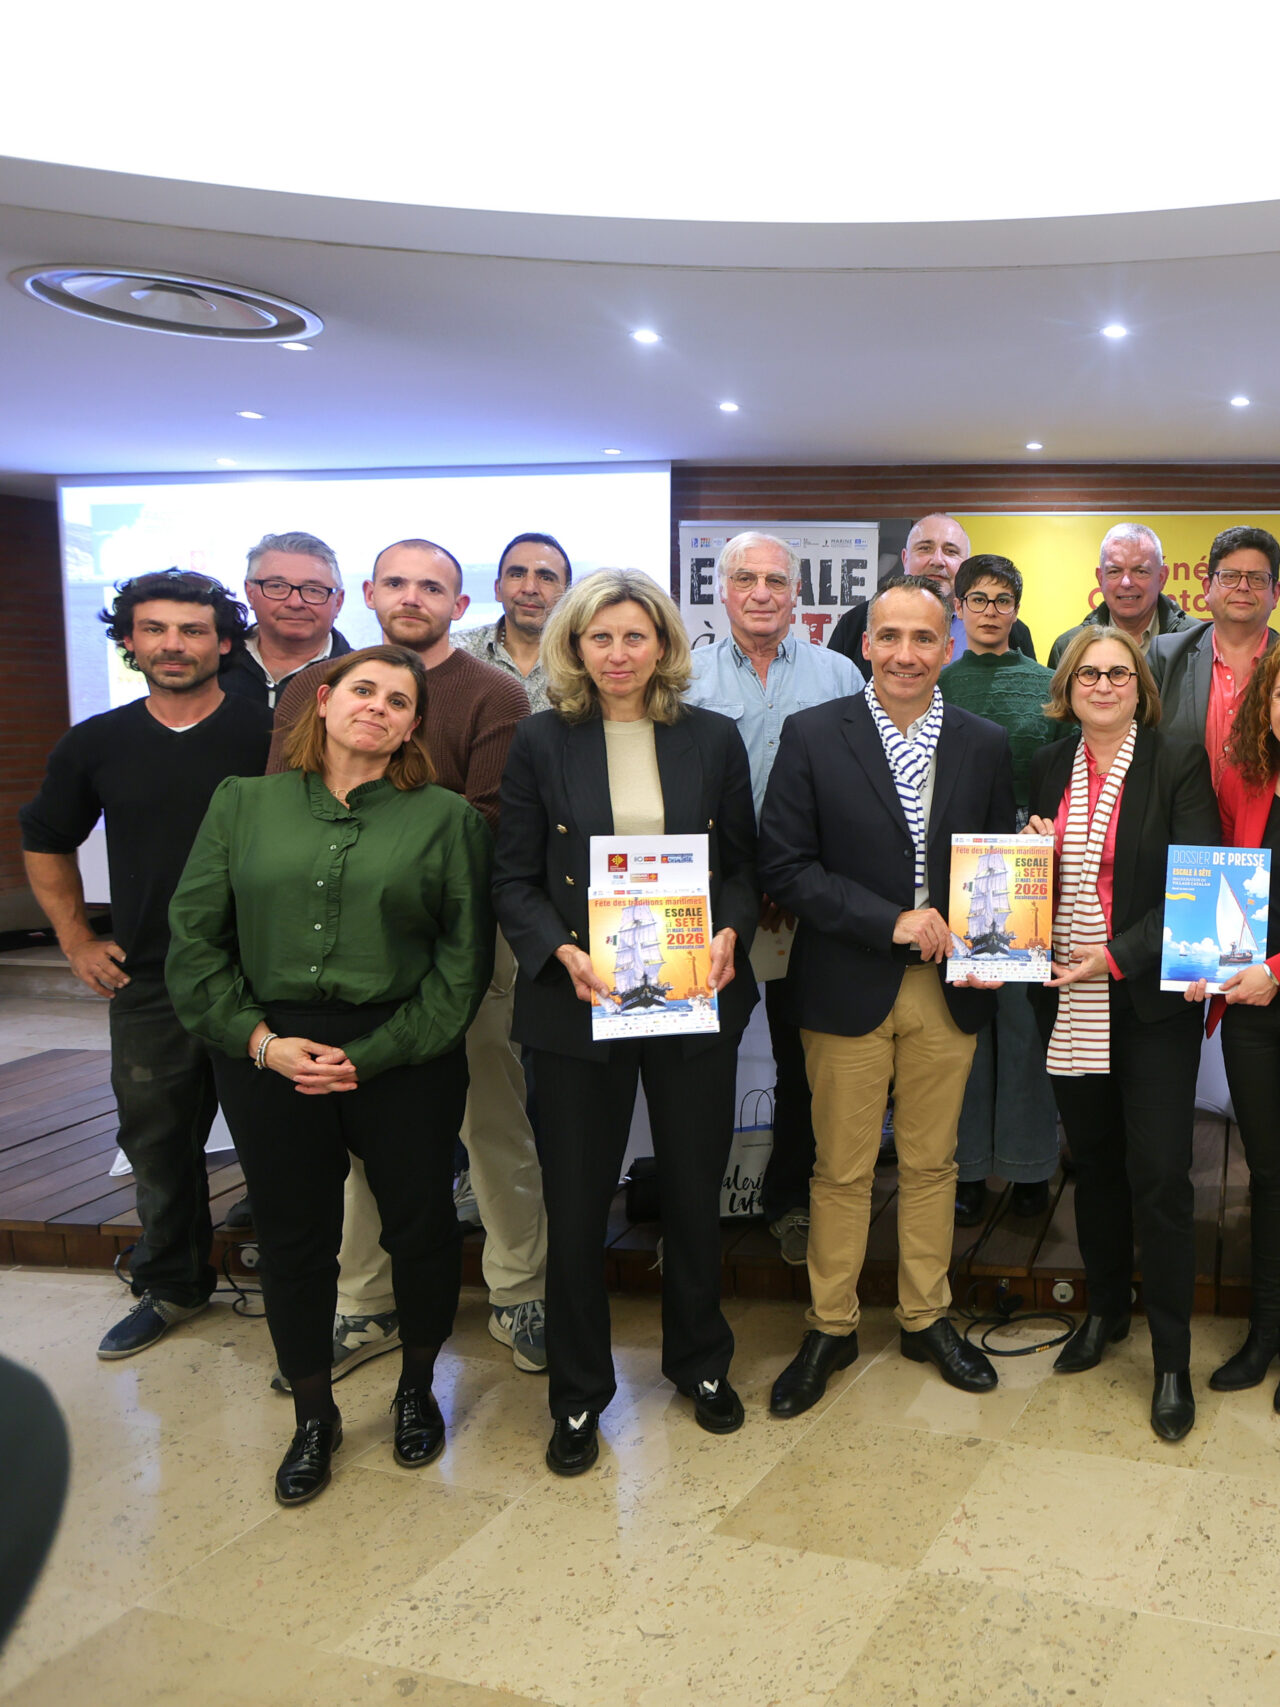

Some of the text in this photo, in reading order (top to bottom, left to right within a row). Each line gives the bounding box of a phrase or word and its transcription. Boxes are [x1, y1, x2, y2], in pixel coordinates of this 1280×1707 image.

[690, 557, 868, 606] EALE
[1015, 857, 1049, 867] ESCALE
[1173, 849, 1265, 867] DOSSIER DE PRESSE
[1014, 883, 1048, 895] 2026
[664, 907, 703, 918] ESCALE
[666, 932, 705, 945] 2026
[722, 1164, 764, 1191] aleri
